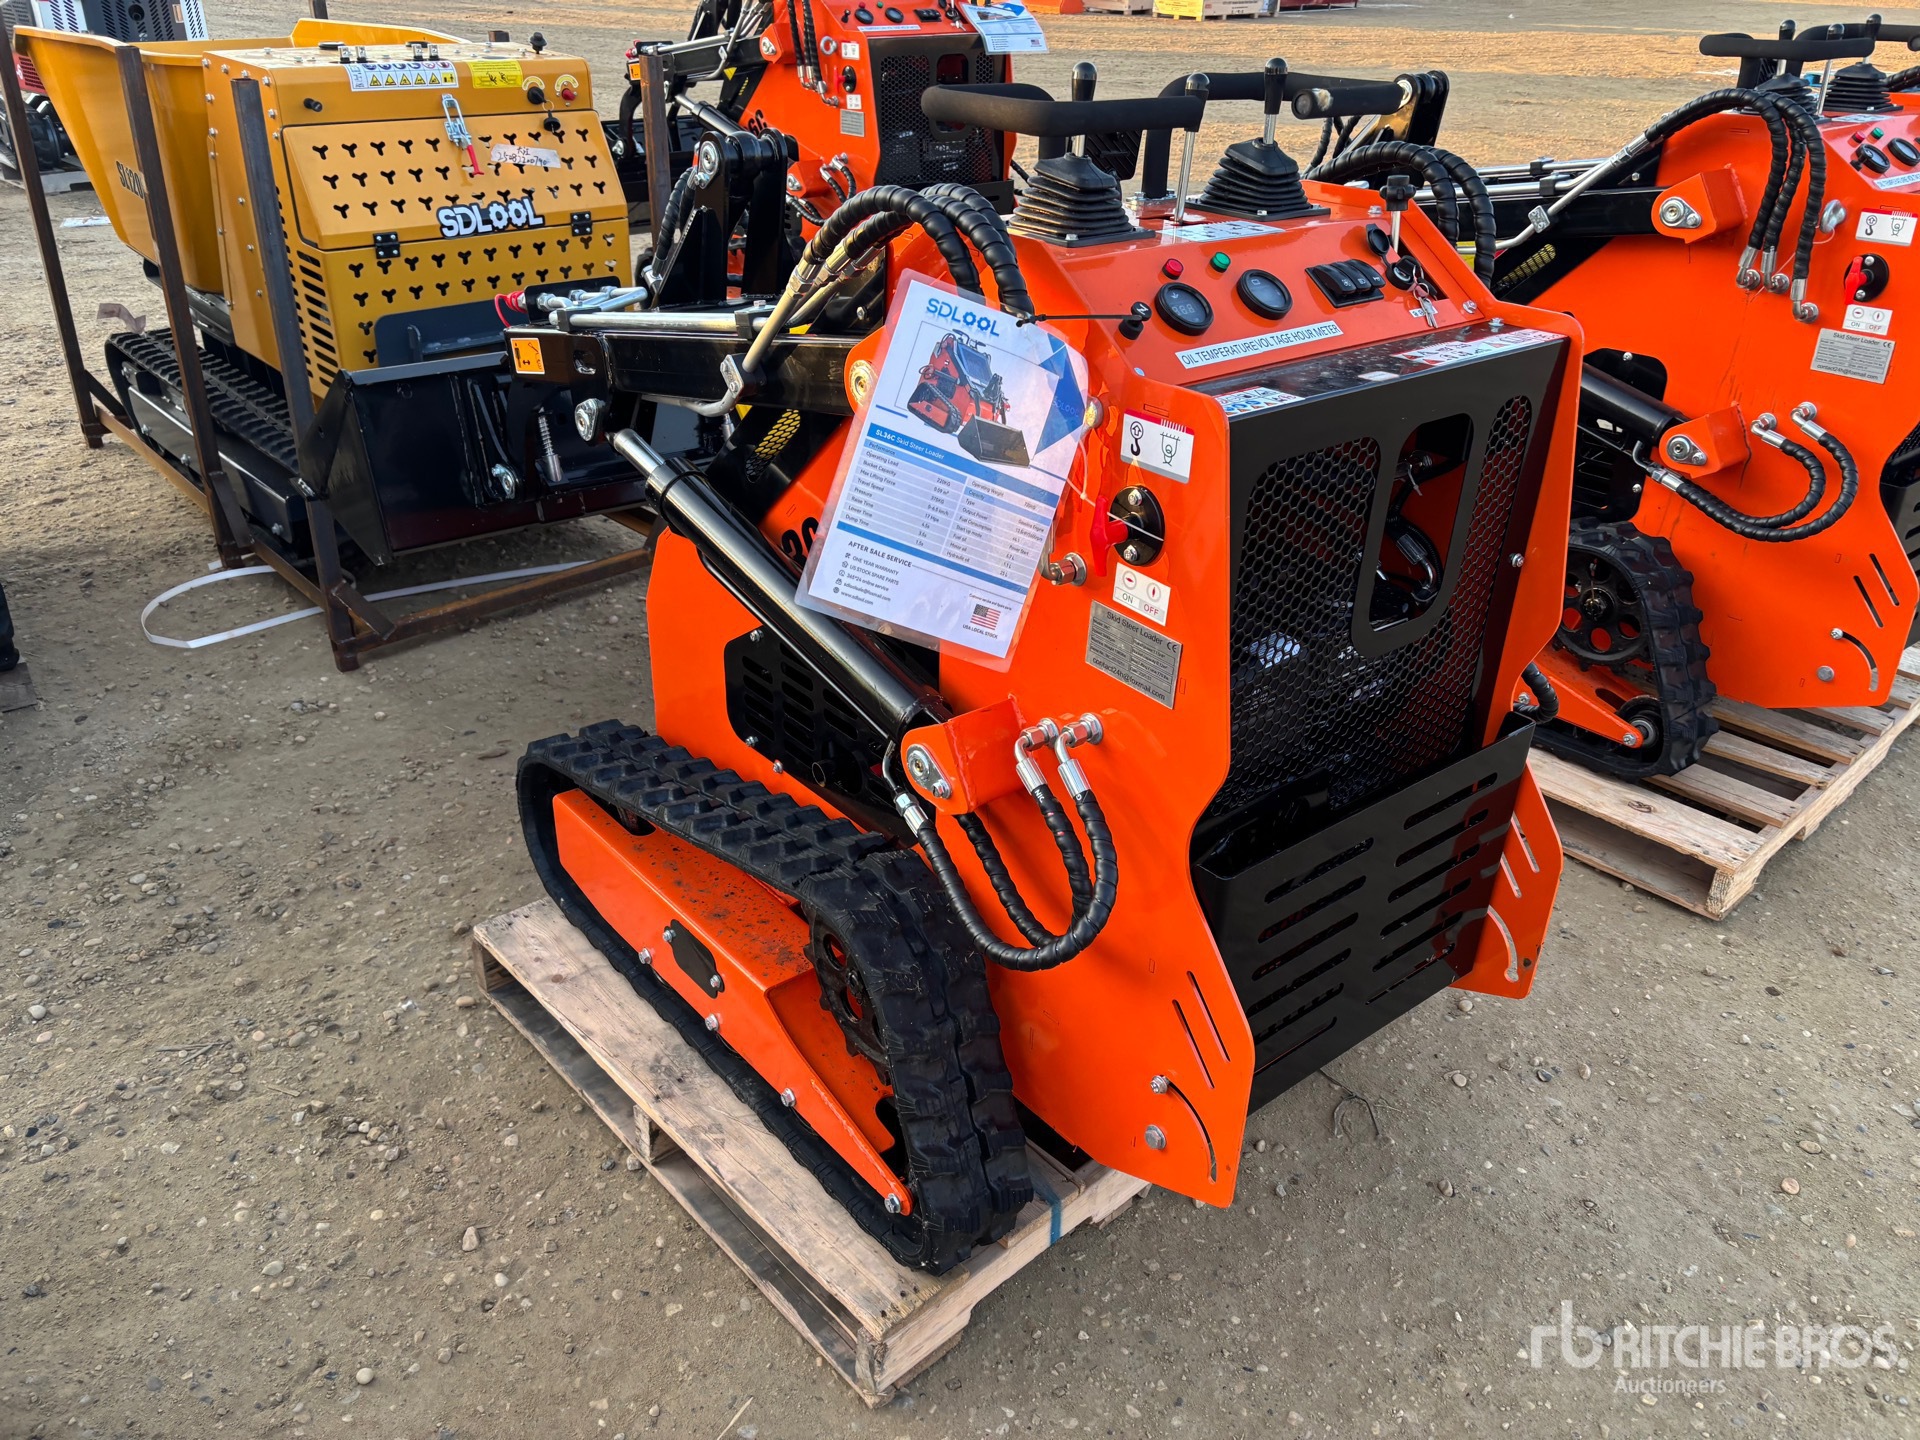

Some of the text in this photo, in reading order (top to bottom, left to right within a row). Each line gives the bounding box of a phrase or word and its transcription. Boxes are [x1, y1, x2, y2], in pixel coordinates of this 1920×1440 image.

[438, 199, 543, 237] SDLOOL
[926, 298, 1000, 336] SDLOOL
[1182, 324, 1340, 365] OIL TEMPERATURE VOLTAGE HOUR METER
[1833, 332, 1844, 340] Skid
[1846, 334, 1860, 342] Steer
[1861, 337, 1880, 346] Loader
[869, 442, 896, 456] Performance
[876, 429, 945, 460] SL36C Skid Steer Loader
[866, 451, 899, 467] Operating Load
[863, 460, 896, 477] Bucket Capacity
[860, 469, 896, 486] Max Lifting Force
[858, 478, 885, 492] Travel Speed
[972, 481, 1004, 498] Operating Weight
[854, 487, 873, 498] Pressure
[968, 489, 985, 500] Capacity
[851, 496, 874, 508] Raise Time
[848, 505, 872, 518] Lower Time
[939, 508, 949, 516] km/h
[963, 507, 988, 521] Output Power
[845, 514, 869, 527] Dump Time
[968, 519, 992, 532] Consumption
[950, 542, 962, 550] Motor
[848, 541, 912, 568] AFTER SALE SERVICE
[947, 551, 964, 561] Hydraulic
[852, 556, 863, 564] ONE
[875, 564, 899, 576] WARRANTY
[856, 566, 871, 576] STOCK
[871, 572, 885, 581] SPARE
[885, 577, 899, 585] PARTS
[862, 579, 874, 587] online
[874, 584, 889, 592] service
[1122, 592, 1159, 616] ON OFF
[971, 627, 984, 635] LOCAL
[984, 631, 998, 639] STOCK
[1106, 611, 1120, 624] Skid
[1122, 619, 1139, 633] Steer
[1140, 628, 1163, 646] Loader
[1092, 658, 1166, 702] contact24h@foxmail.com
